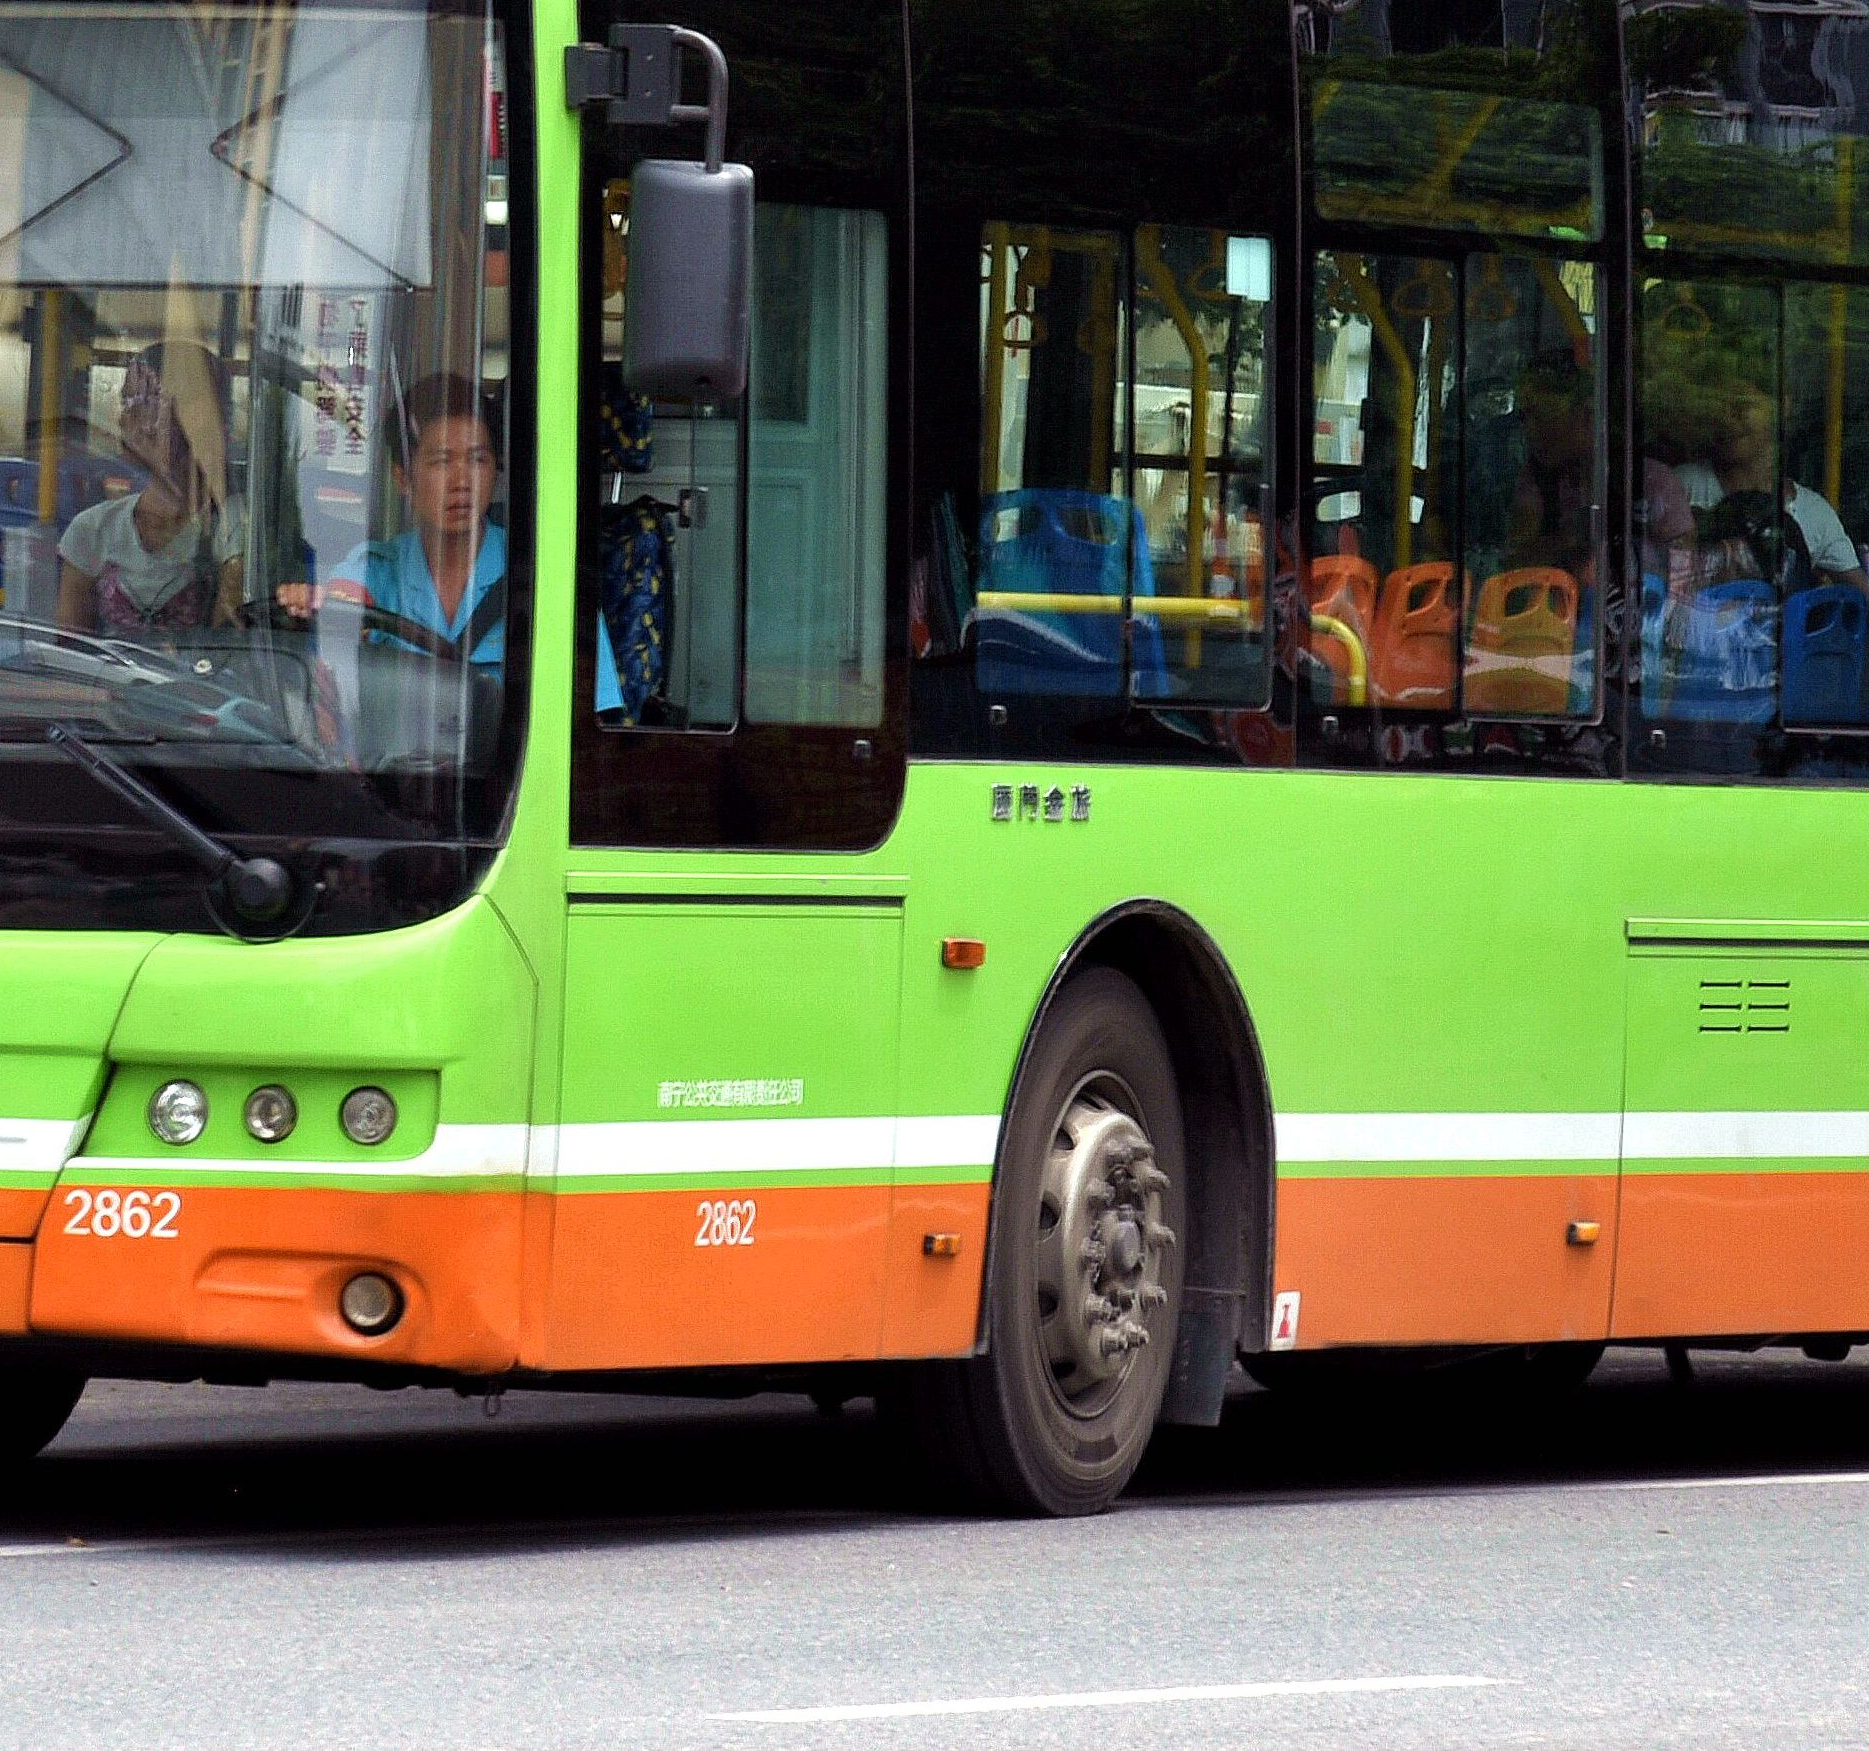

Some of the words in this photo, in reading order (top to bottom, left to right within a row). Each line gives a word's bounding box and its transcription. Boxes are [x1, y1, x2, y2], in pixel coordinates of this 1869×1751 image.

[991, 783, 1091, 821] 厦门金旅
[63, 1190, 181, 1238] 2862
[694, 1198, 757, 1247] 2862
